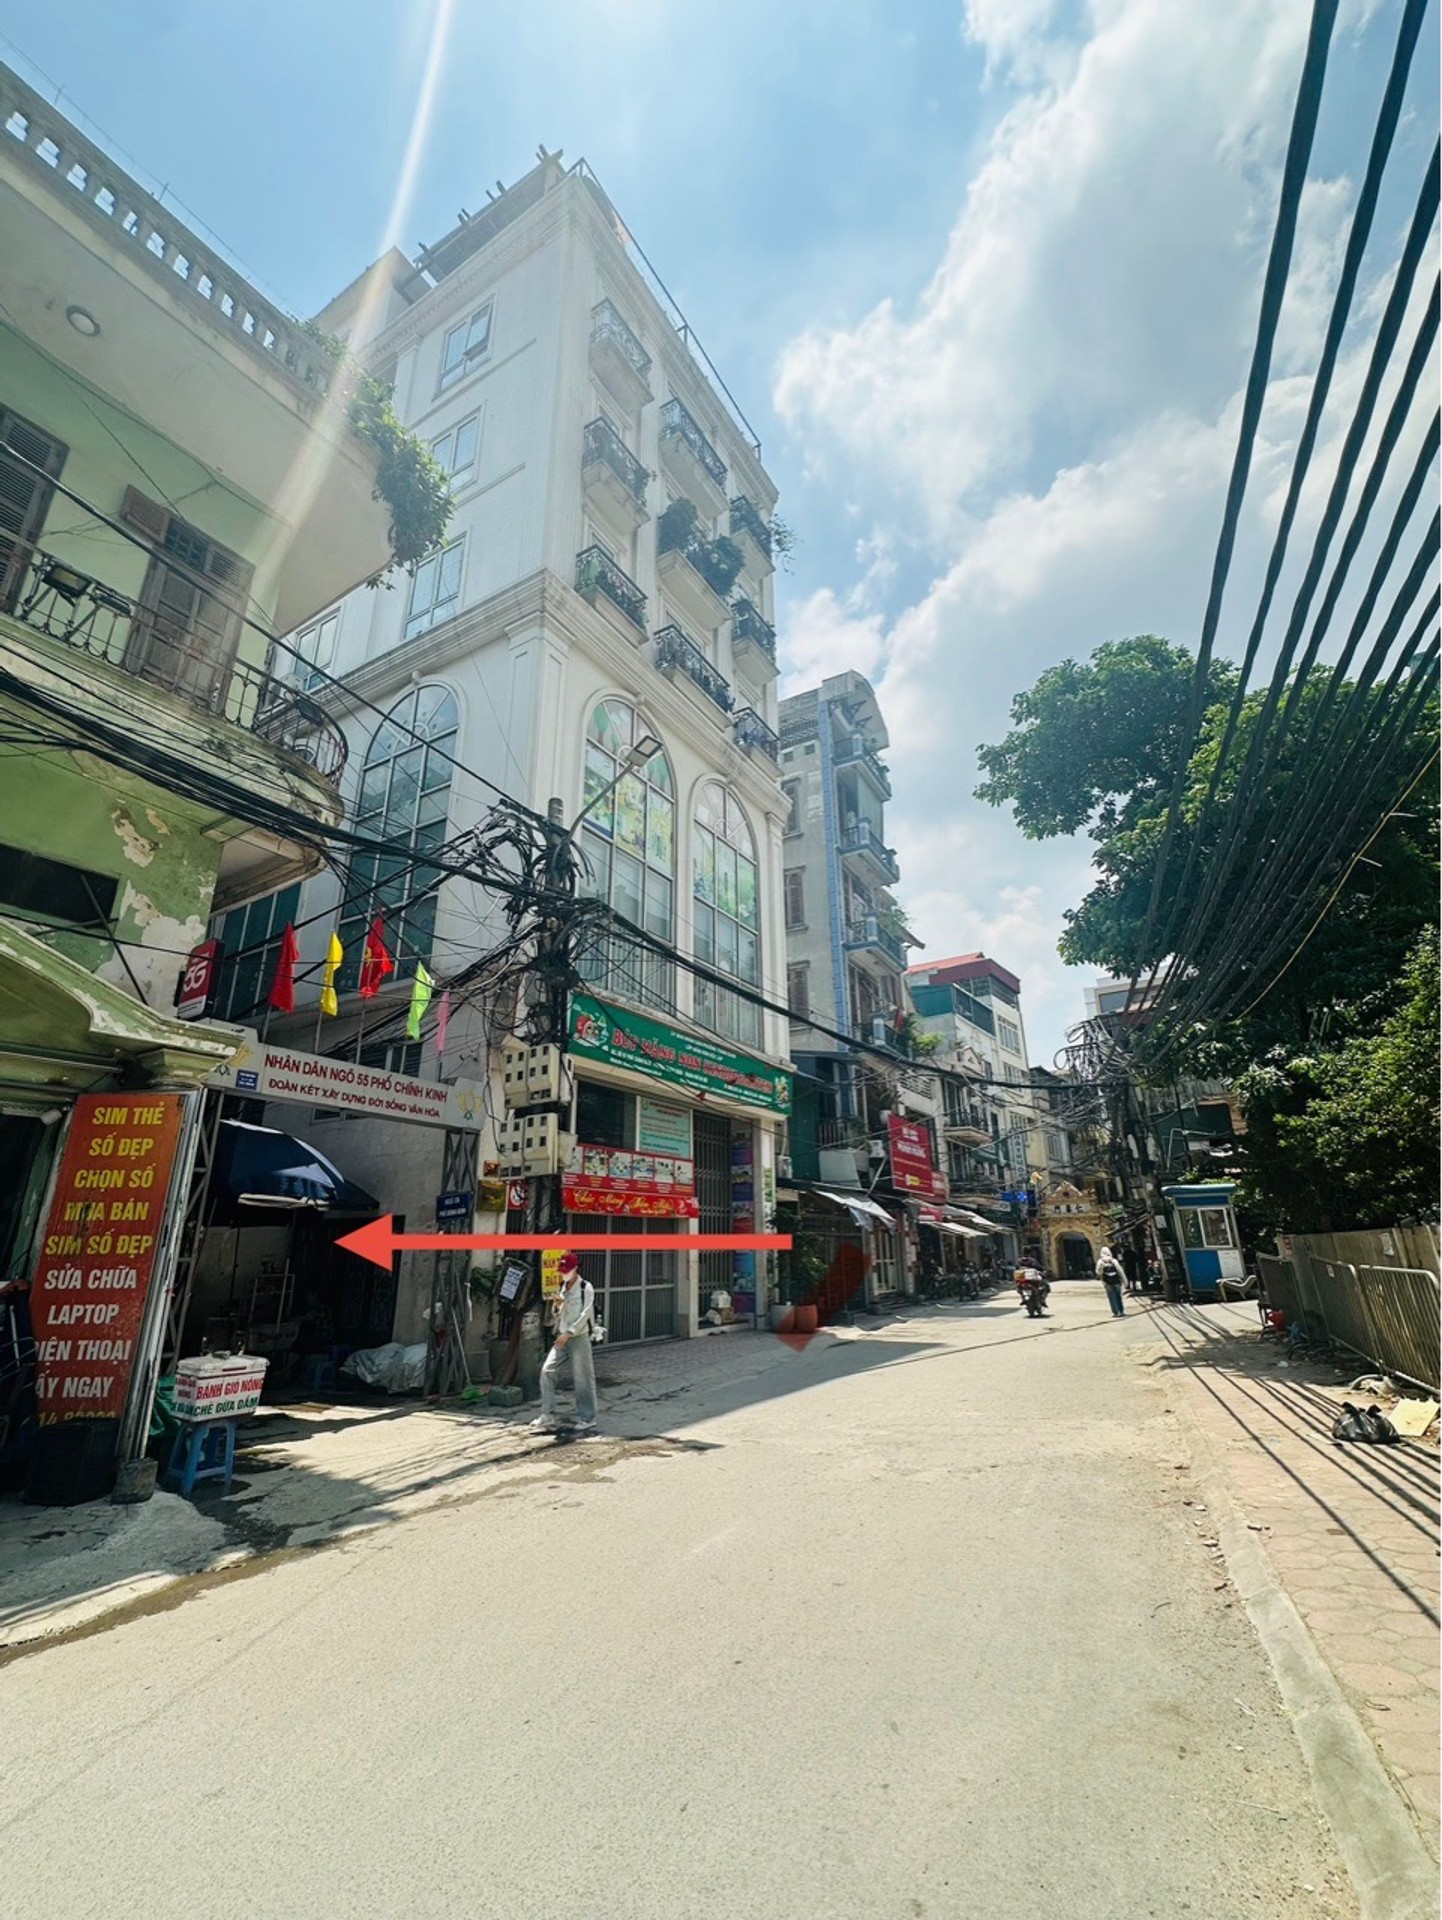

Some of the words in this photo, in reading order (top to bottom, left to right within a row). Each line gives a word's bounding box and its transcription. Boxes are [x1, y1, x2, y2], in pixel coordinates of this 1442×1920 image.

[183, 960, 208, 992] 5G
[264, 1053, 301, 1073] NHÂN
[302, 1060, 328, 1079] DÂN
[329, 1067, 355, 1084] NGÕ
[357, 1073, 369, 1087] 55
[370, 1074, 392, 1091] PHỐ
[394, 1080, 424, 1098] CHÍNH
[425, 1087, 448, 1103] KINH
[268, 1078, 298, 1092] ĐOÀN
[300, 1083, 320, 1096] KẾT
[321, 1088, 340, 1101] XÂY
[341, 1092, 366, 1106] DỰNG
[368, 1095, 384, 1107] ĐỜI
[385, 1098, 407, 1112] SỐNG
[408, 1104, 423, 1116] VĂN
[424, 1107, 441, 1118] HÓA
[92, 1106, 128, 1125] SIM
[132, 1101, 165, 1125] THẺ
[88, 1131, 117, 1156] SỐ
[117, 1138, 154, 1160] ĐẸP
[74, 1169, 126, 1192] CHỌN
[128, 1162, 157, 1188] SỐ
[110, 1197, 150, 1221] BÁN
[45, 1235, 83, 1255] SIM
[87, 1228, 115, 1254] SỐ
[116, 1235, 153, 1258] ĐẸP
[44, 1263, 83, 1290] SỬA
[87, 1265, 137, 1290] CHỮA
[47, 1304, 120, 1325] LAPTOP
[77, 1340, 132, 1365] THOẠI
[35, 1370, 60, 1399] ẤY
[62, 1376, 114, 1398] NGAY
[196, 1382, 223, 1400] BÁNH
[224, 1379, 240, 1395] GIÒ
